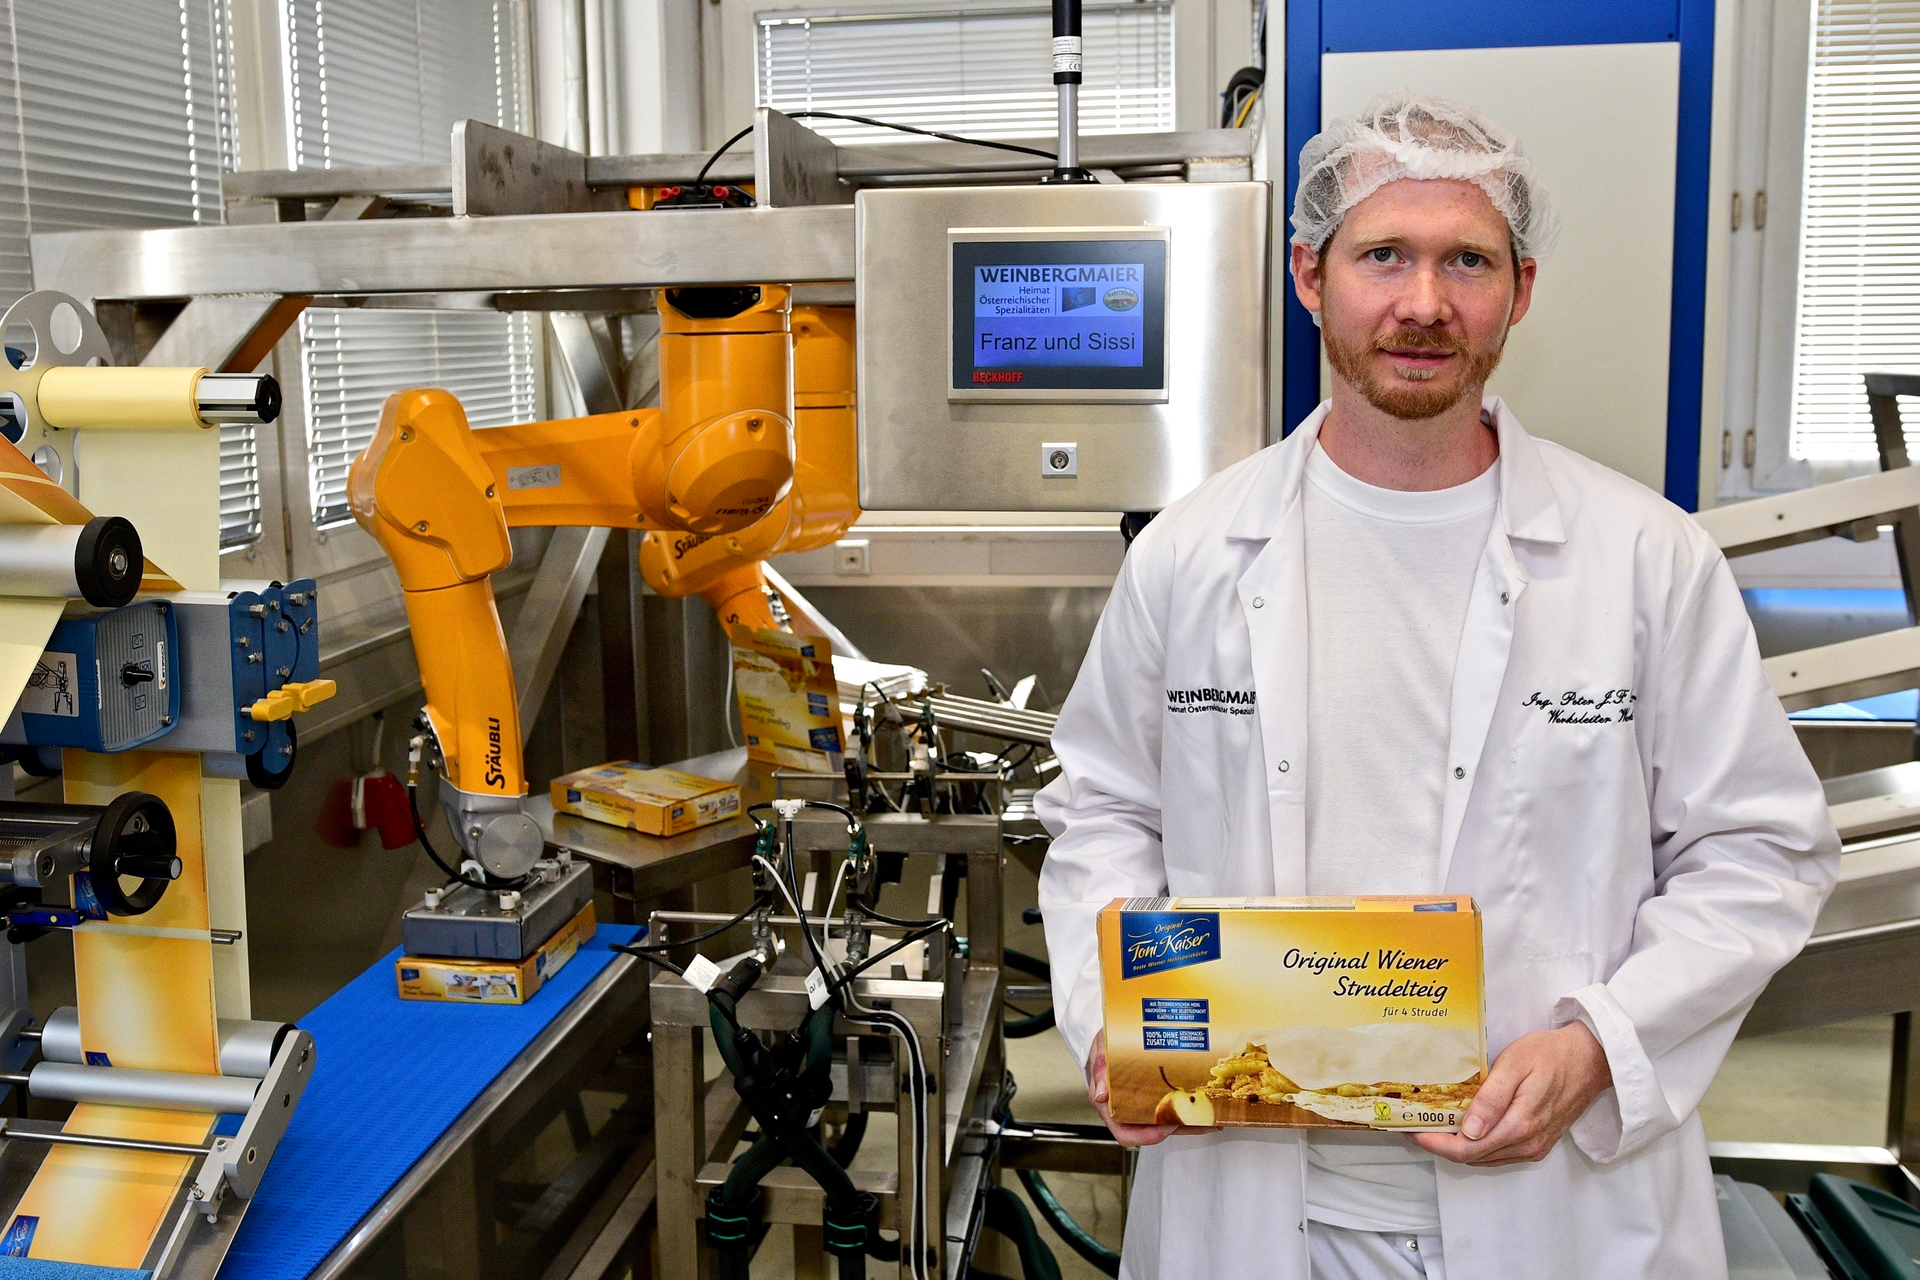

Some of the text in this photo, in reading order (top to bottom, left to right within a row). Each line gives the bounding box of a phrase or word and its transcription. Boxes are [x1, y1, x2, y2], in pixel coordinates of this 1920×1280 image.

[980, 267, 1139, 283] WEINBERGMAIER
[1018, 286, 1050, 294] Heimat
[979, 294, 1050, 304] Österreichischer
[995, 306, 1050, 316] Spezialitäten
[981, 332, 1135, 350] Franz und Sissi
[973, 372, 1023, 383] BECKHOFF
[1522, 692, 1553, 710] Ing.
[1560, 691, 1595, 706] Peter
[1547, 710, 1612, 724] Werksleiter
[485, 716, 505, 790] STÄUBLI
[1154, 919, 1184, 934] Original
[1128, 928, 1210, 962] Toni Kaiser
[1283, 948, 1449, 976] Original Wiener
[1333, 976, 1448, 1004] Strudelteig
[1382, 1006, 1448, 1018] für 4 Strudel
[1418, 1112, 1444, 1122] 1000
[1448, 1113, 1455, 1126] g
